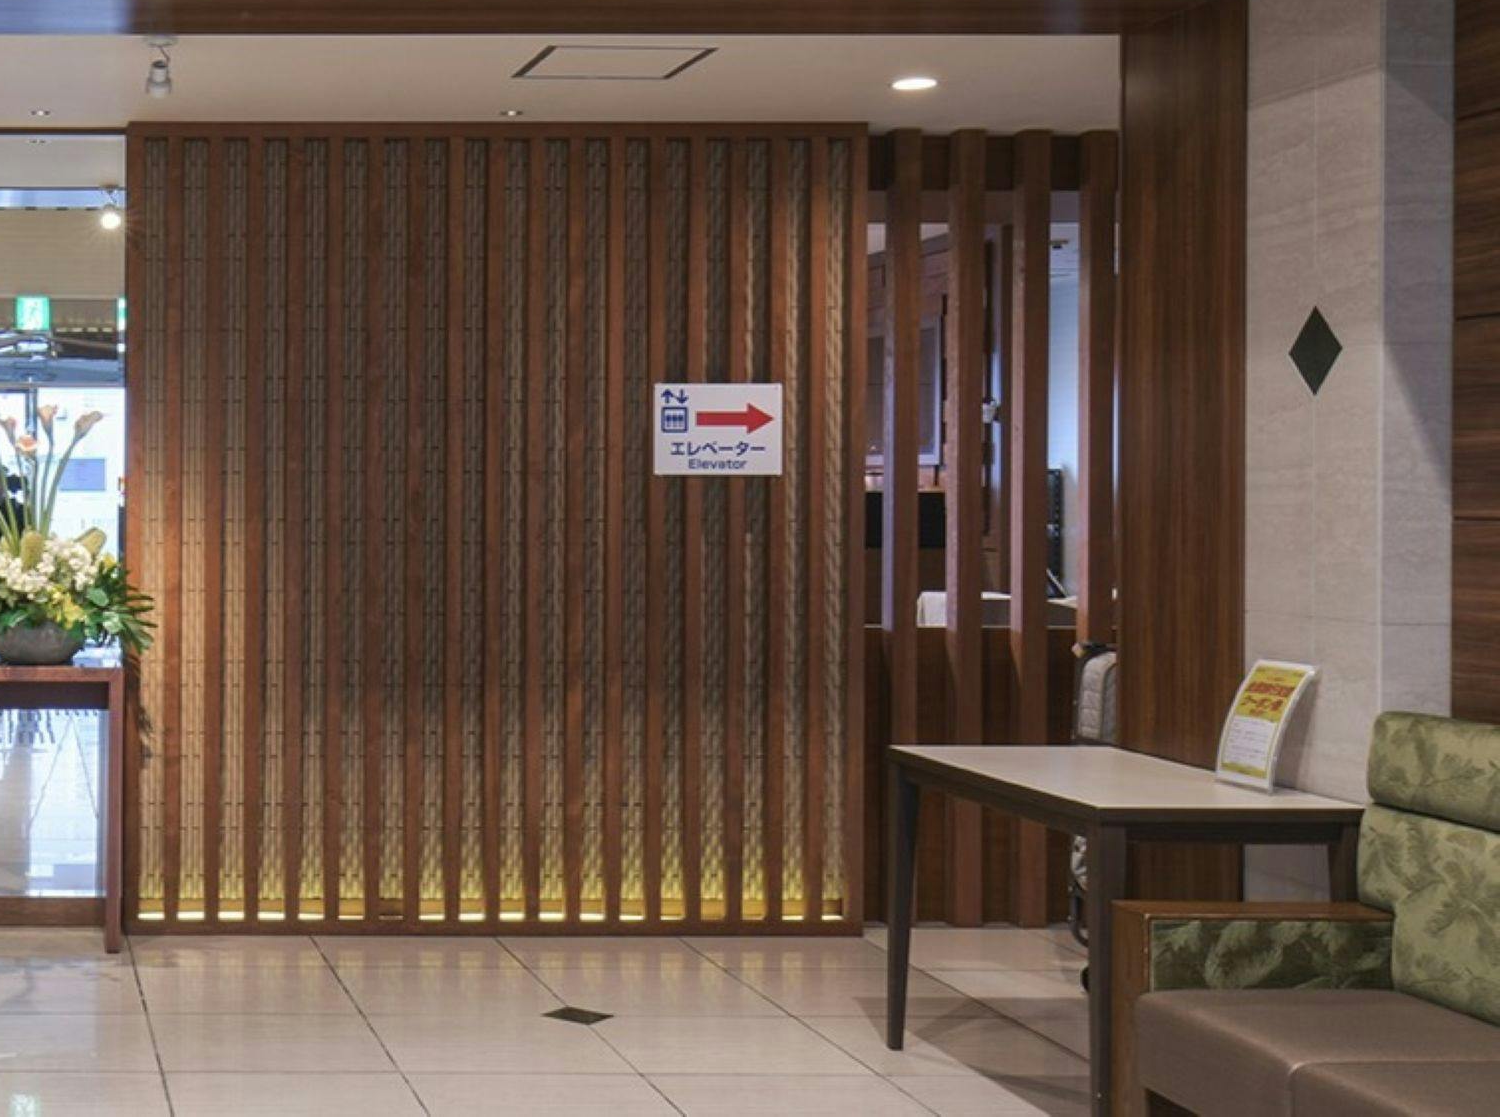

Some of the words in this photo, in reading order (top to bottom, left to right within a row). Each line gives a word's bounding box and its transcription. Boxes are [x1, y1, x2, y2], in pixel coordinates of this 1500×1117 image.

[670, 441, 766, 456] エレベーター
[688, 459, 748, 470] Elevator
